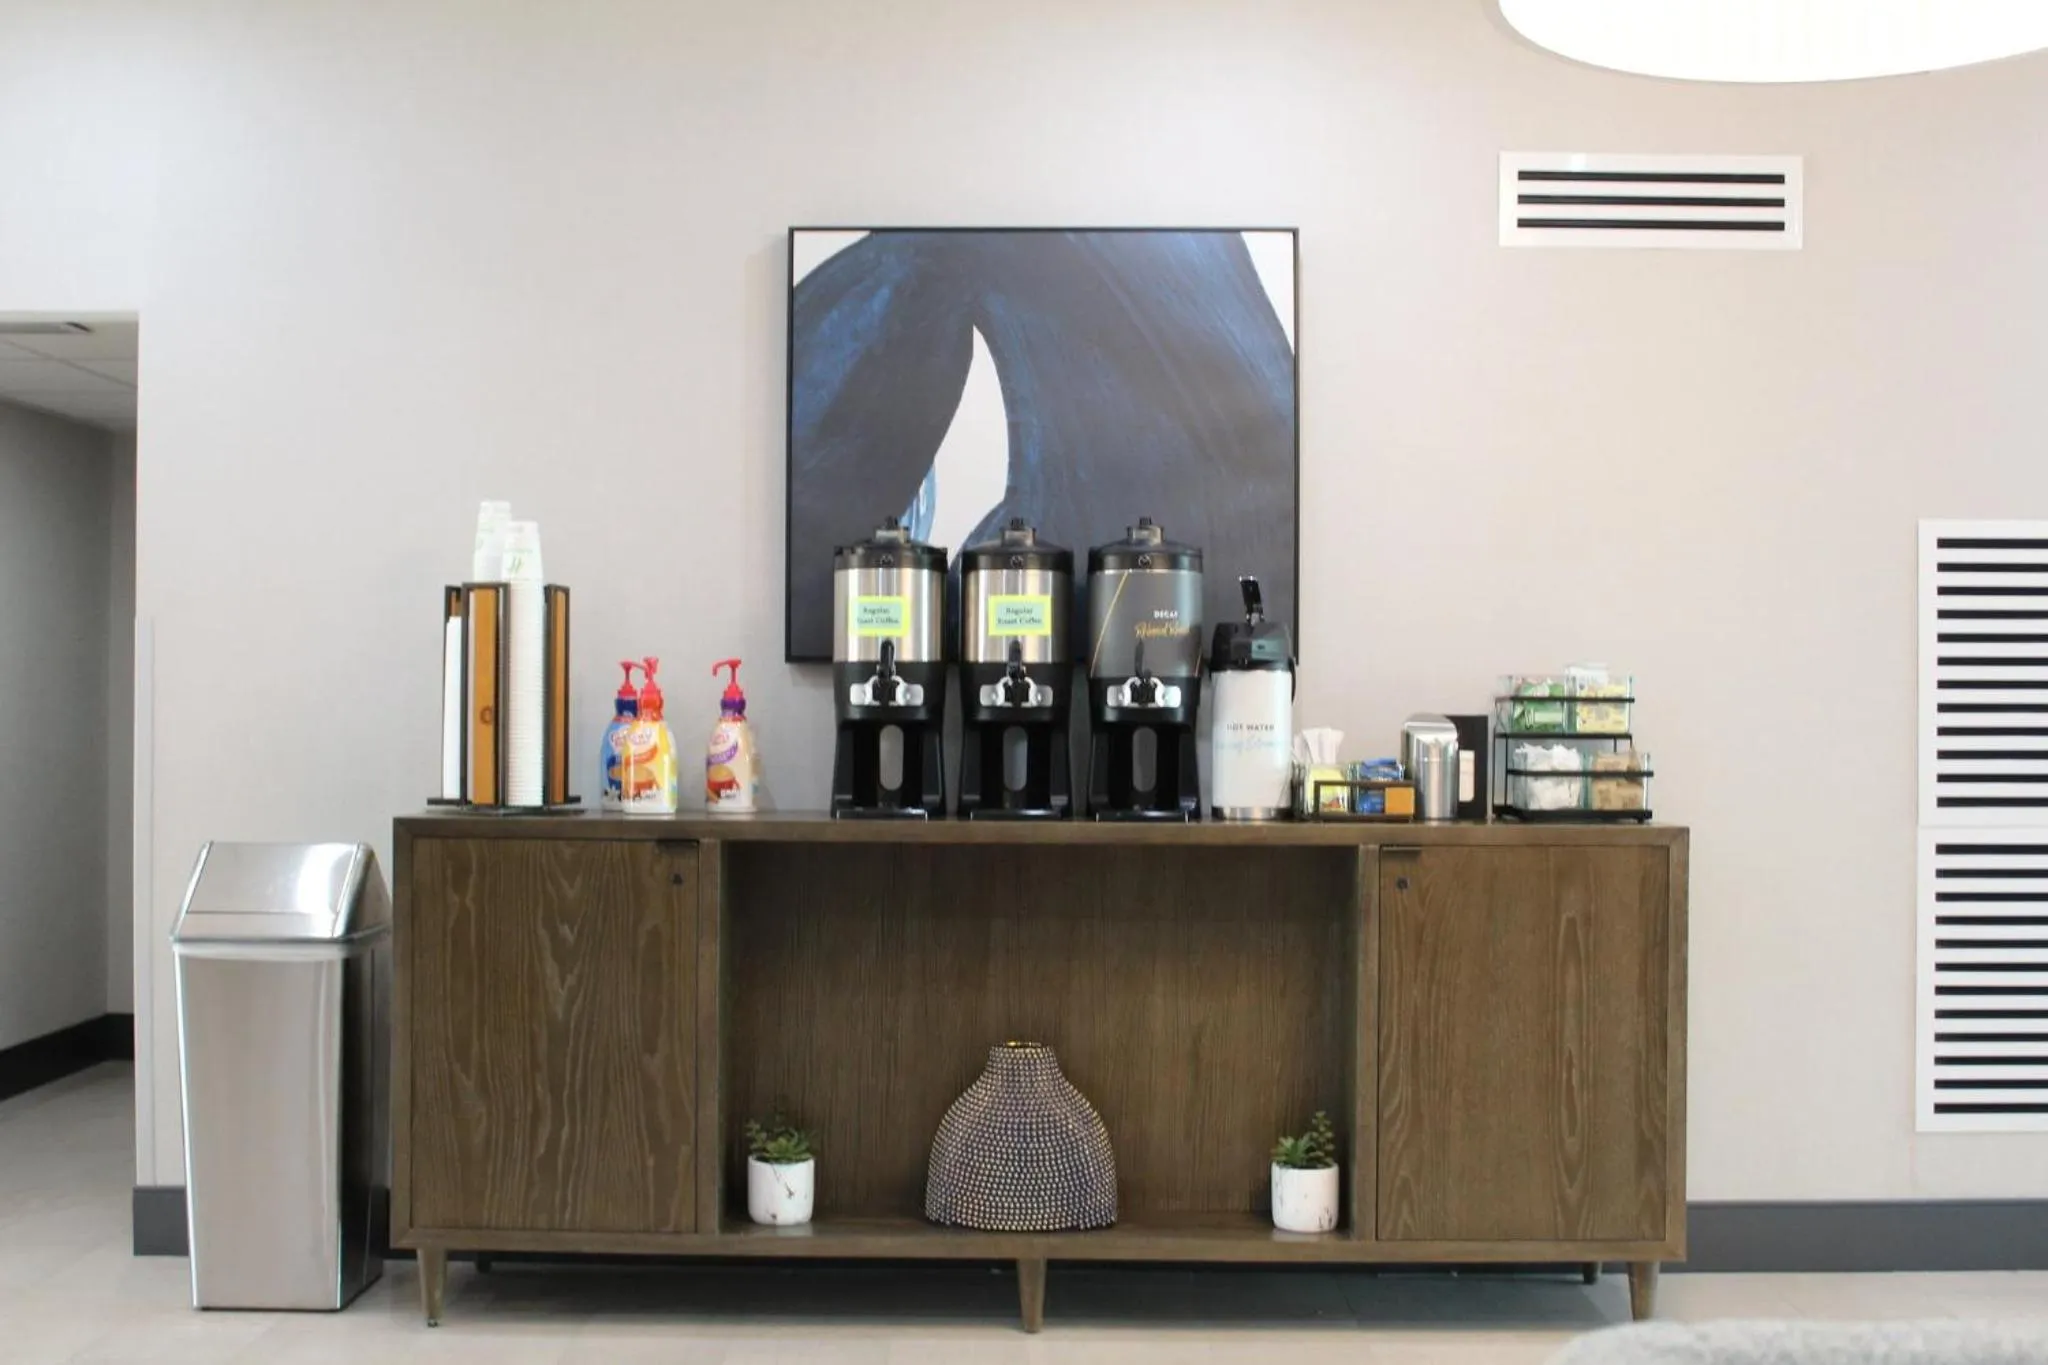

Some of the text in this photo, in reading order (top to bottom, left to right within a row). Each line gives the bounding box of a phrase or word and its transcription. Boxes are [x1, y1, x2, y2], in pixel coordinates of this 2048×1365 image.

[1005, 606, 1033, 616] Regular
[1153, 610, 1178, 619] DECAF
[1226, 723, 1275, 731] HOT WATER
